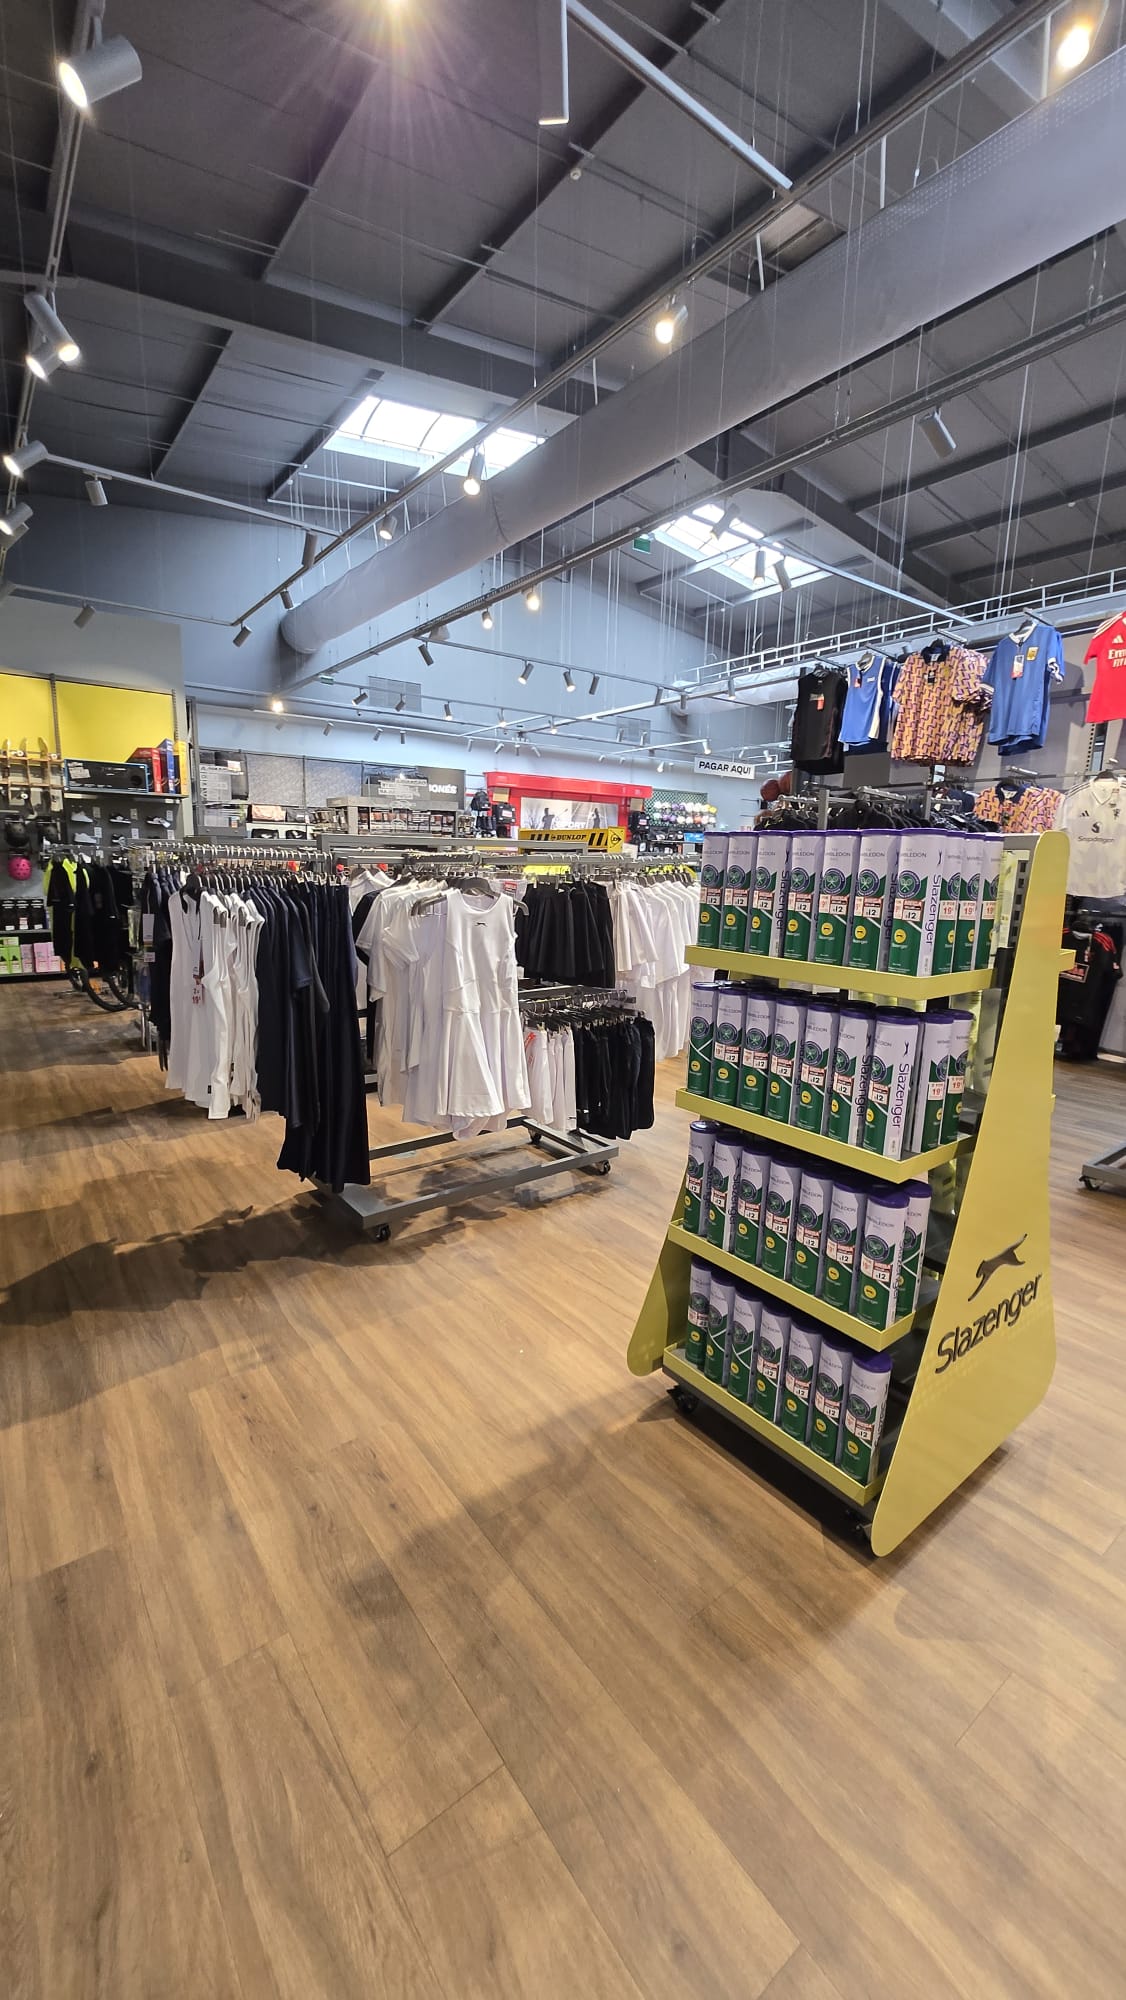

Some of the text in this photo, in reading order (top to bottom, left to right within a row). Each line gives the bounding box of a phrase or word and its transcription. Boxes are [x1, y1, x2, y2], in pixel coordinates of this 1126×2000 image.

[698, 760, 752, 775] PAGAR AQUI
[775, 871, 789, 930] Slazenger
[924, 874, 941, 945] Slazenger
[855, 1055, 872, 1117] Slazenger
[890, 1063, 910, 1127] Slazenger
[935, 1273, 1042, 1374] Slazenger
